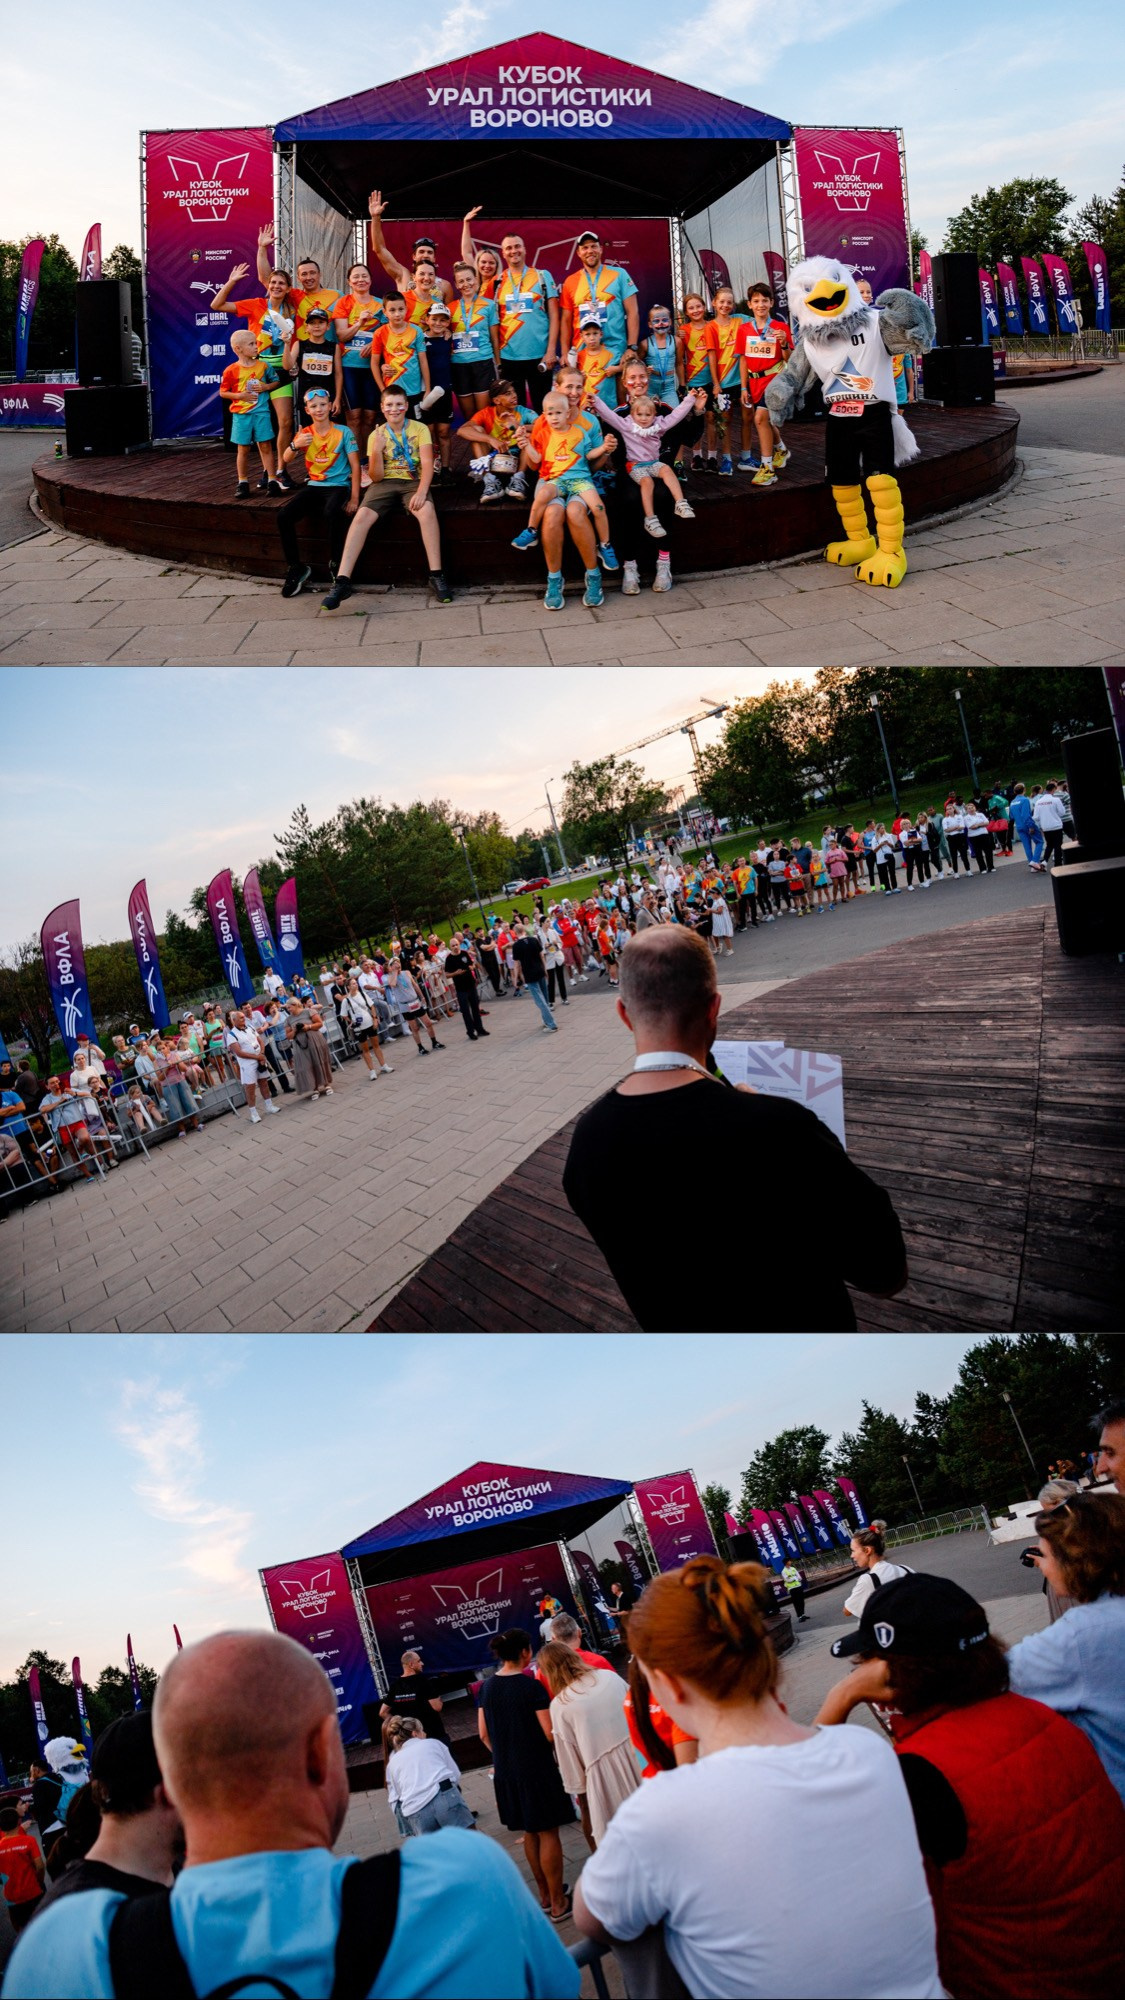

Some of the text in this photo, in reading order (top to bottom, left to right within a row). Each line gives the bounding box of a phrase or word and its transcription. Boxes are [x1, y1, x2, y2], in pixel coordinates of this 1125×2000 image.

[499, 66, 583, 84] КУБОК
[426, 88, 652, 106] УРАЛ ЛОГИСТИКИ
[470, 109, 614, 128] ВОРОНОВО
[189, 180, 222, 189] КУБОК
[835, 174, 861, 182] КУБОК
[835, 182, 883, 190] ЛОГИСТИКИ
[163, 188, 249, 199] УРАЛ ЛОГИСТИКИ
[179, 197, 233, 207] ВОРОНОВО
[209, 312, 228, 320] URAL
[351, 339, 366, 347] 132
[851, 333, 865, 346] 01
[750, 346, 771, 354] 1048
[306, 363, 328, 372] 1035
[3, 398, 29, 409] ВФЛА
[825, 393, 879, 404] ВЕРШИНА
[215, 897, 234, 944] ВФЛА
[251, 909, 265, 939] URAL
[280, 914, 291, 933] НГК
[53, 931, 75, 985] ВФЛА
[462, 1477, 511, 1497] КУБОК
[424, 1481, 552, 1519] УРАЛ ЛОГИСТИКИ
[453, 1499, 533, 1527] ВОРОНОВО
[282, 1590, 336, 1608] УРАЛ ЛОГИСТИКИ
[297, 1589, 319, 1598] КУБОК
[293, 1598, 328, 1610] ВОРОНОВО
[457, 1598, 487, 1611] КУБОК
[435, 1599, 512, 1625] УРАЛ ЛОГИСТИКИ
[452, 1610, 500, 1629] ВОРОНОВО
